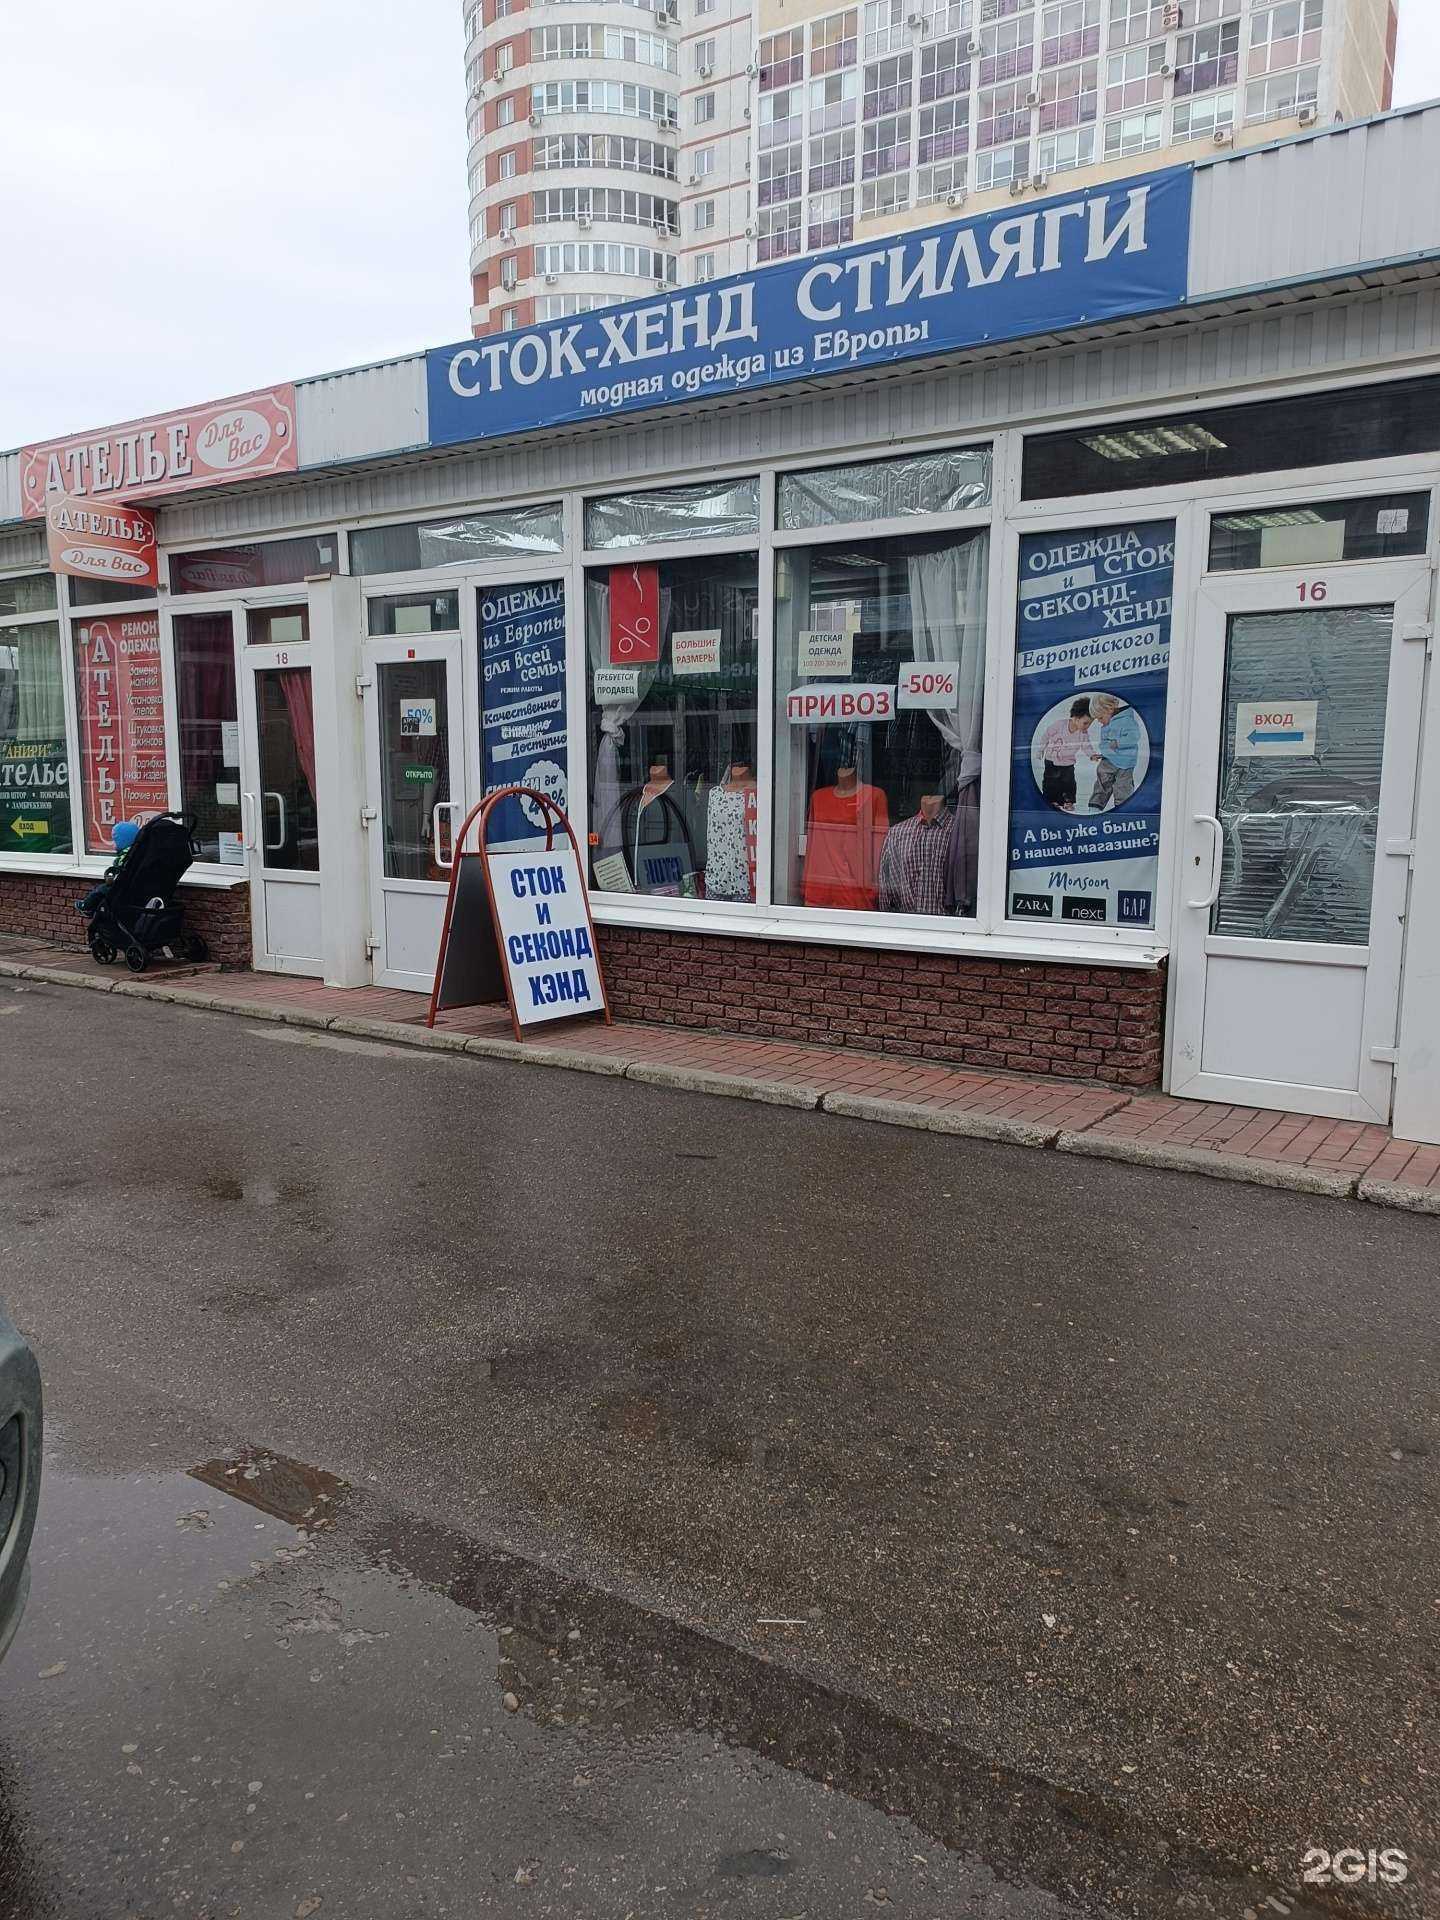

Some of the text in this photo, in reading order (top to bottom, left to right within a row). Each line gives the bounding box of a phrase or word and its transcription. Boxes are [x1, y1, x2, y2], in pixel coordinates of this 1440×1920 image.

[449, 186, 1150, 398] СТОК-ХЕНД СТИЛЯГИ
[579, 319, 930, 407] модная одежда из Европы
[204, 417, 245, 448] Для
[46, 423, 193, 497] АТЕЛЬЕ
[228, 433, 262, 463] Вас
[57, 508, 146, 542] АТЕЛЬЕ
[70, 550, 143, 573] Для Вас
[1028, 530, 1141, 571] ОДЕЖДА
[1063, 543, 1174, 589] и СТОК
[1024, 583, 1137, 621] СЕКОНД-
[1296, 581, 1327, 602] 16
[1103, 597, 1171, 629] ХЕНД
[483, 634, 500, 650] из
[675, 638, 716, 650] БОЛЬШИЕ
[809, 634, 843, 644] ДЕТСКАЯ
[1021, 632, 1154, 668] Европейского
[275, 652, 289, 665] 18
[676, 653, 715, 665] РАЗМЕРЫ
[808, 647, 842, 657] ОДЕЖДА
[484, 660, 511, 682] для
[1078, 651, 1169, 679] качества
[597, 673, 634, 682] ТРЕБУЕТСЯ
[902, 674, 953, 694] -50%
[597, 686, 635, 696] ПРОДАВЕЦ
[484, 698, 560, 725] Качественно
[1254, 713, 1295, 727] ВХОД
[0, 762, 68, 786] телье
[405, 770, 433, 779] ОТКРЫТО
[152, 790, 168, 803] услу
[1024, 829, 1037, 844] А
[1066, 823, 1098, 843] уже
[1103, 819, 1147, 835] были
[1024, 845, 1074, 860] нашем
[1077, 832, 1160, 854] магазине?
[510, 865, 567, 898] СТОК
[1048, 871, 1110, 891] Monsoon
[535, 902, 552, 925] И
[1016, 896, 1147, 920] ZARA next GAP
[508, 926, 593, 965] СЕКОНД
[528, 968, 591, 1006] ХЭНД
